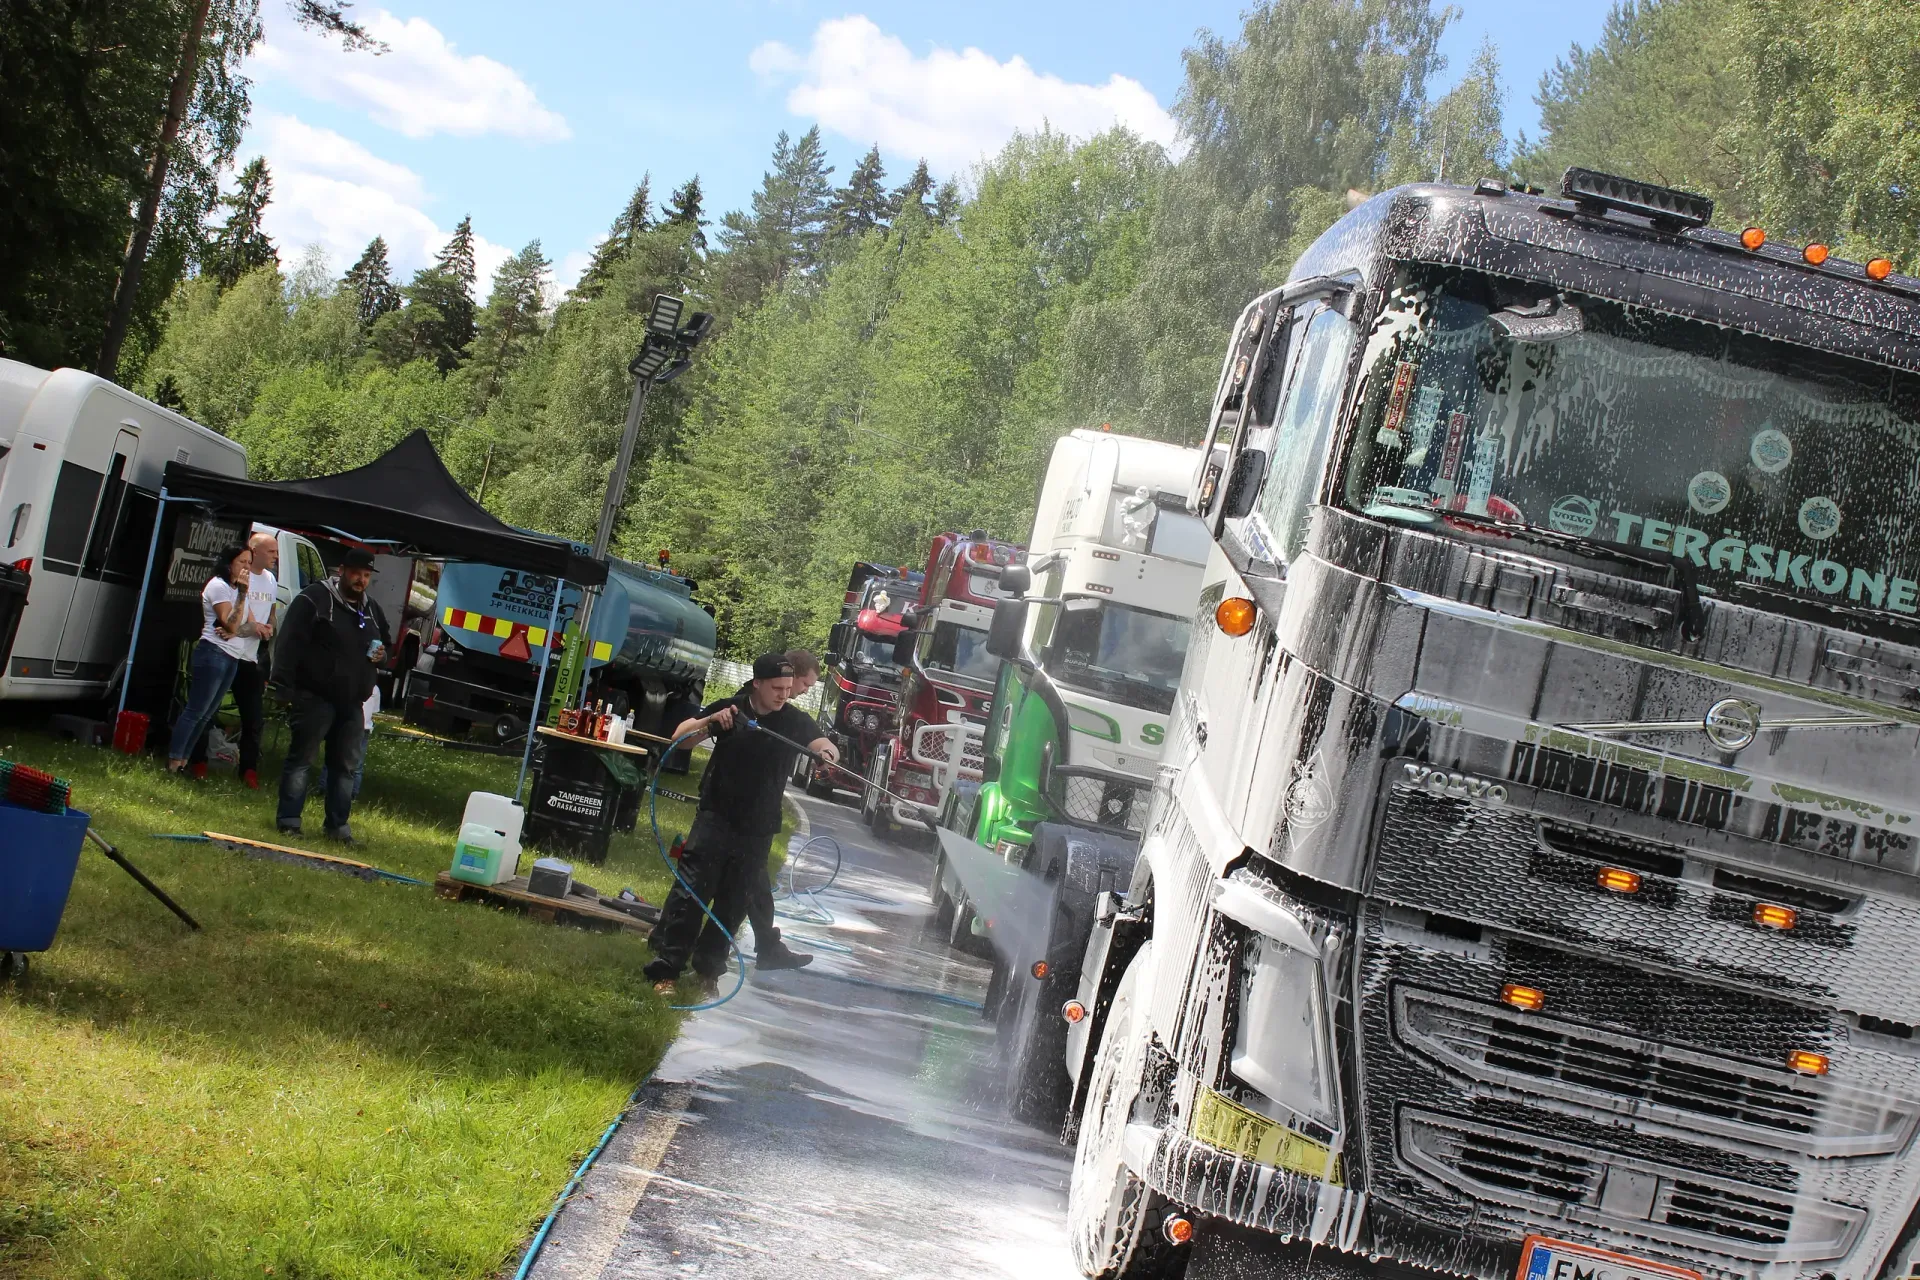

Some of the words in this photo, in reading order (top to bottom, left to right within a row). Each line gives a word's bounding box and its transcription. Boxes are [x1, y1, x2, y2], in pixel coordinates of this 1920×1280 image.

[1553, 511, 1594, 527] VOLVO
[1609, 511, 1919, 613] TERÄSKONE
[504, 603, 549, 620] HEIKKILÄ
[557, 668, 570, 694] K50
[1403, 763, 1508, 804] VOLVO
[558, 790, 603, 807] TAMPEREEN
[556, 801, 601, 817] RASKASPESUT
[1287, 799, 1328, 819] VOLVO
